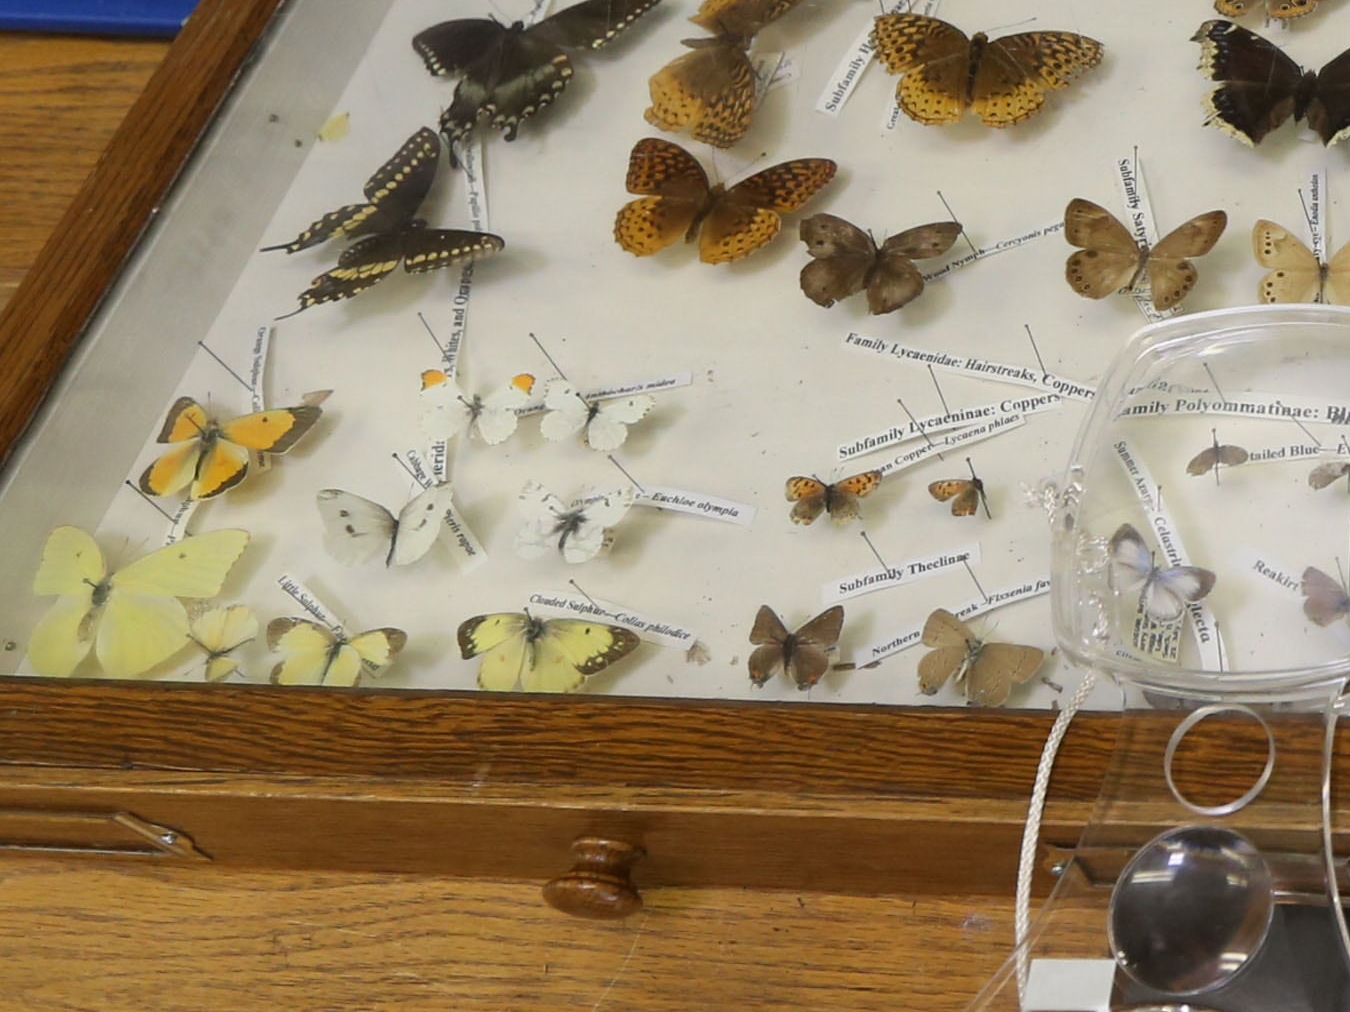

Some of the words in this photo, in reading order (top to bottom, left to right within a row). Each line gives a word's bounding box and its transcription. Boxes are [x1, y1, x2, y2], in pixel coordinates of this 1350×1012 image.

[824, 54, 866, 113] Subfamily
[1118, 158, 1140, 210] Subfamily
[453, 307, 465, 327] and
[846, 332, 889, 354] Family
[890, 343, 964, 369] Lycaenidae:
[964, 359, 1039, 384] Hairstreaks,
[839, 426, 905, 460] Subfamily
[909, 404, 996, 435] Lycaeninae:
[1000, 392, 1062, 413] Coppers
[988, 413, 1021, 434] phlaes
[1175, 398, 1320, 421] Polyommatinae:
[1114, 440, 1139, 476] Summer
[652, 492, 696, 507] Euchloe
[696, 499, 740, 518] olympia
[839, 568, 904, 594] Subfamily
[907, 551, 971, 576] Theclinae
[530, 593, 567, 609] Clouded
[645, 622, 692, 640] philodice
[872, 630, 921, 657] Northern
